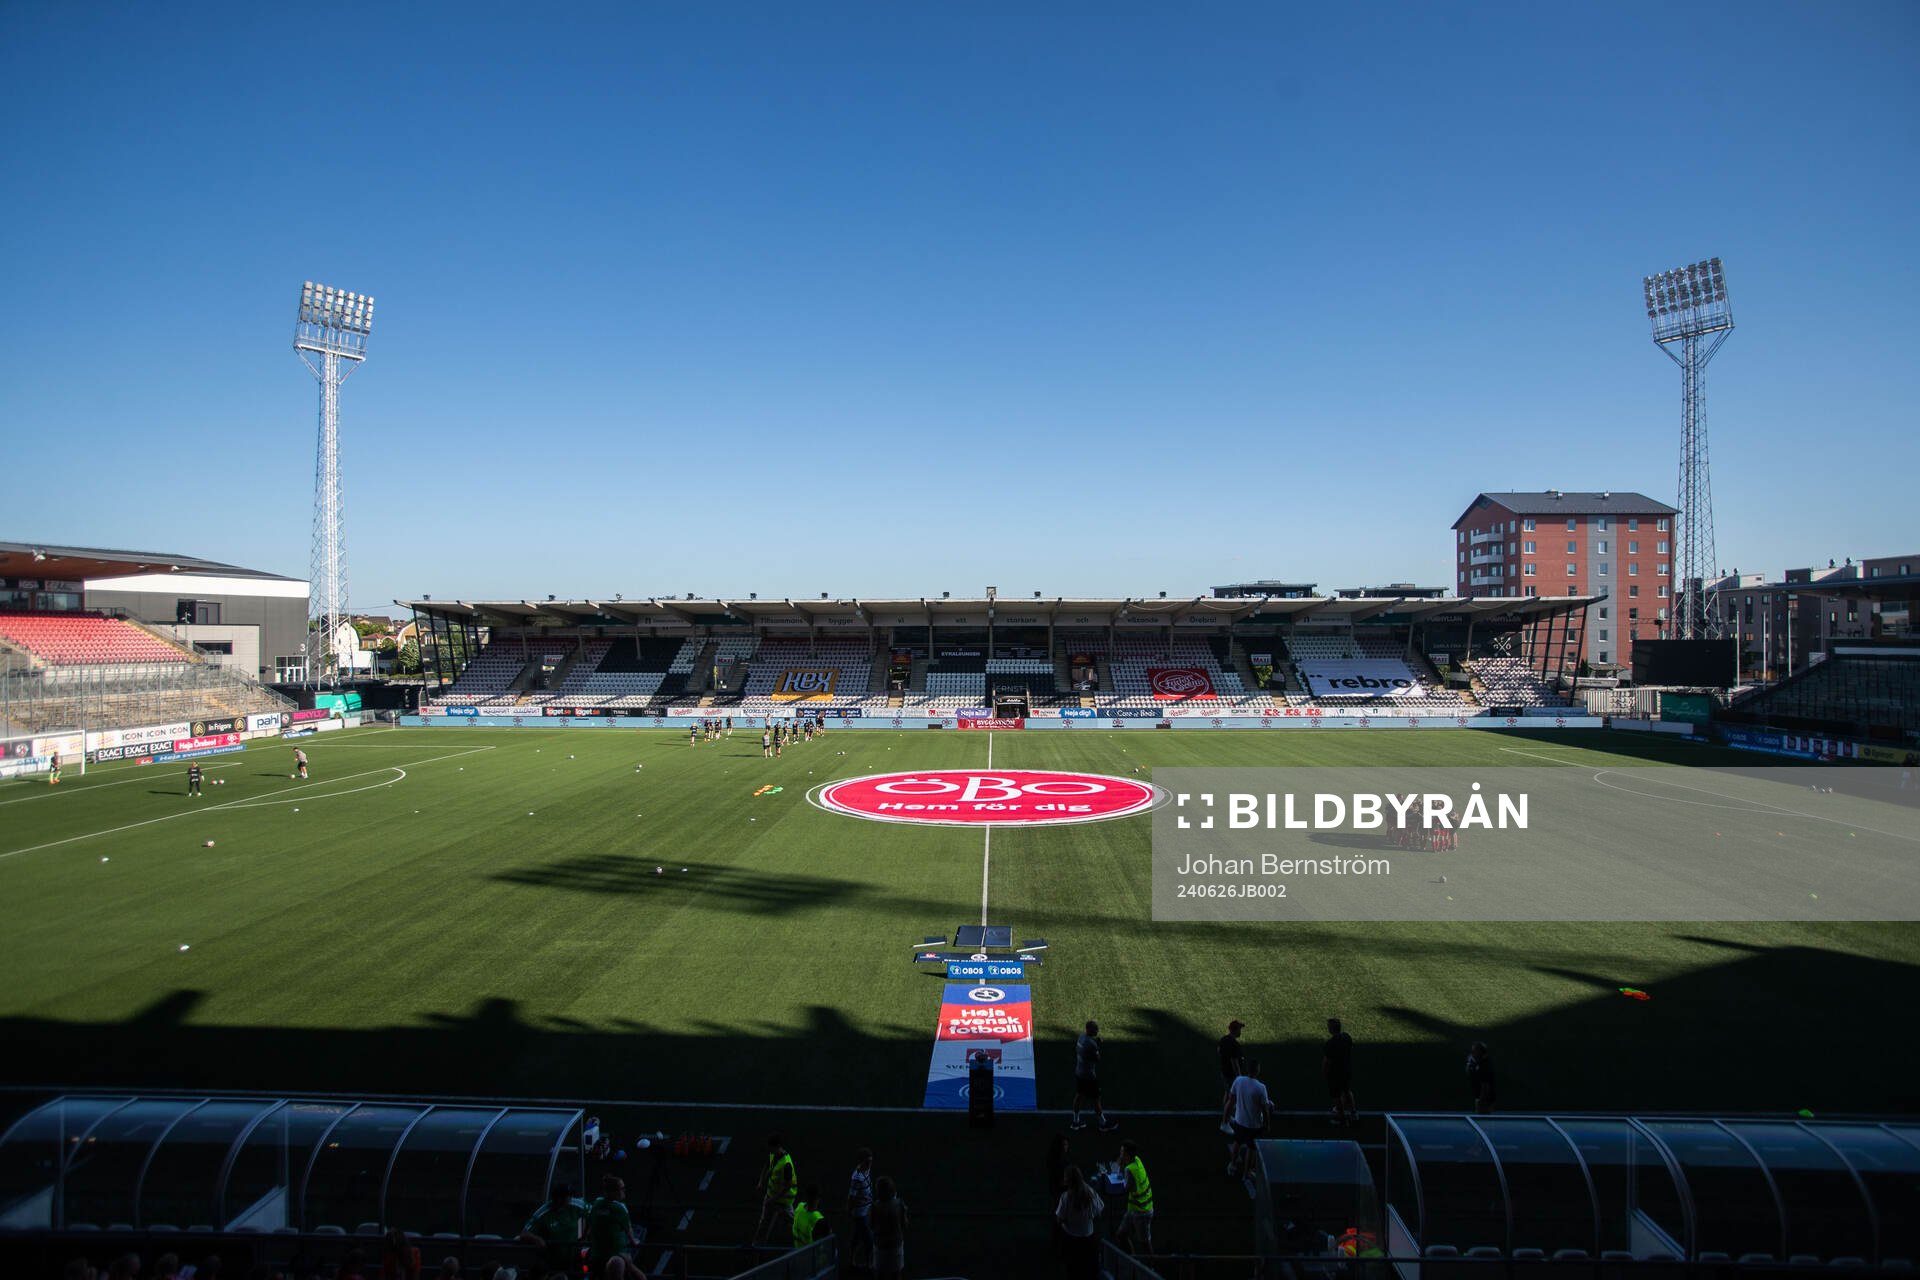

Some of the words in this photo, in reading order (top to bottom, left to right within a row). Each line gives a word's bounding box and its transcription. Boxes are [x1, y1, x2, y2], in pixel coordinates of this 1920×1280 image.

[257, 716, 280, 729] pahl
[147, 729, 166, 738] ICON
[169, 727, 188, 735] ICON
[122, 732, 143, 741] ICON
[125, 745, 148, 755] EXACT
[150, 742, 174, 752] EXACT
[98, 748, 124, 758] EXACT
[875, 777, 1105, 802] ÖBO
[877, 803, 960, 812] Hem
[974, 803, 1021, 811] för
[1035, 803, 1092, 812] dig
[962, 967, 984, 975] OBOS
[1000, 967, 1022, 975] OBOS
[961, 1008, 1006, 1018] Heja
[950, 1016, 1021, 1025] svensk
